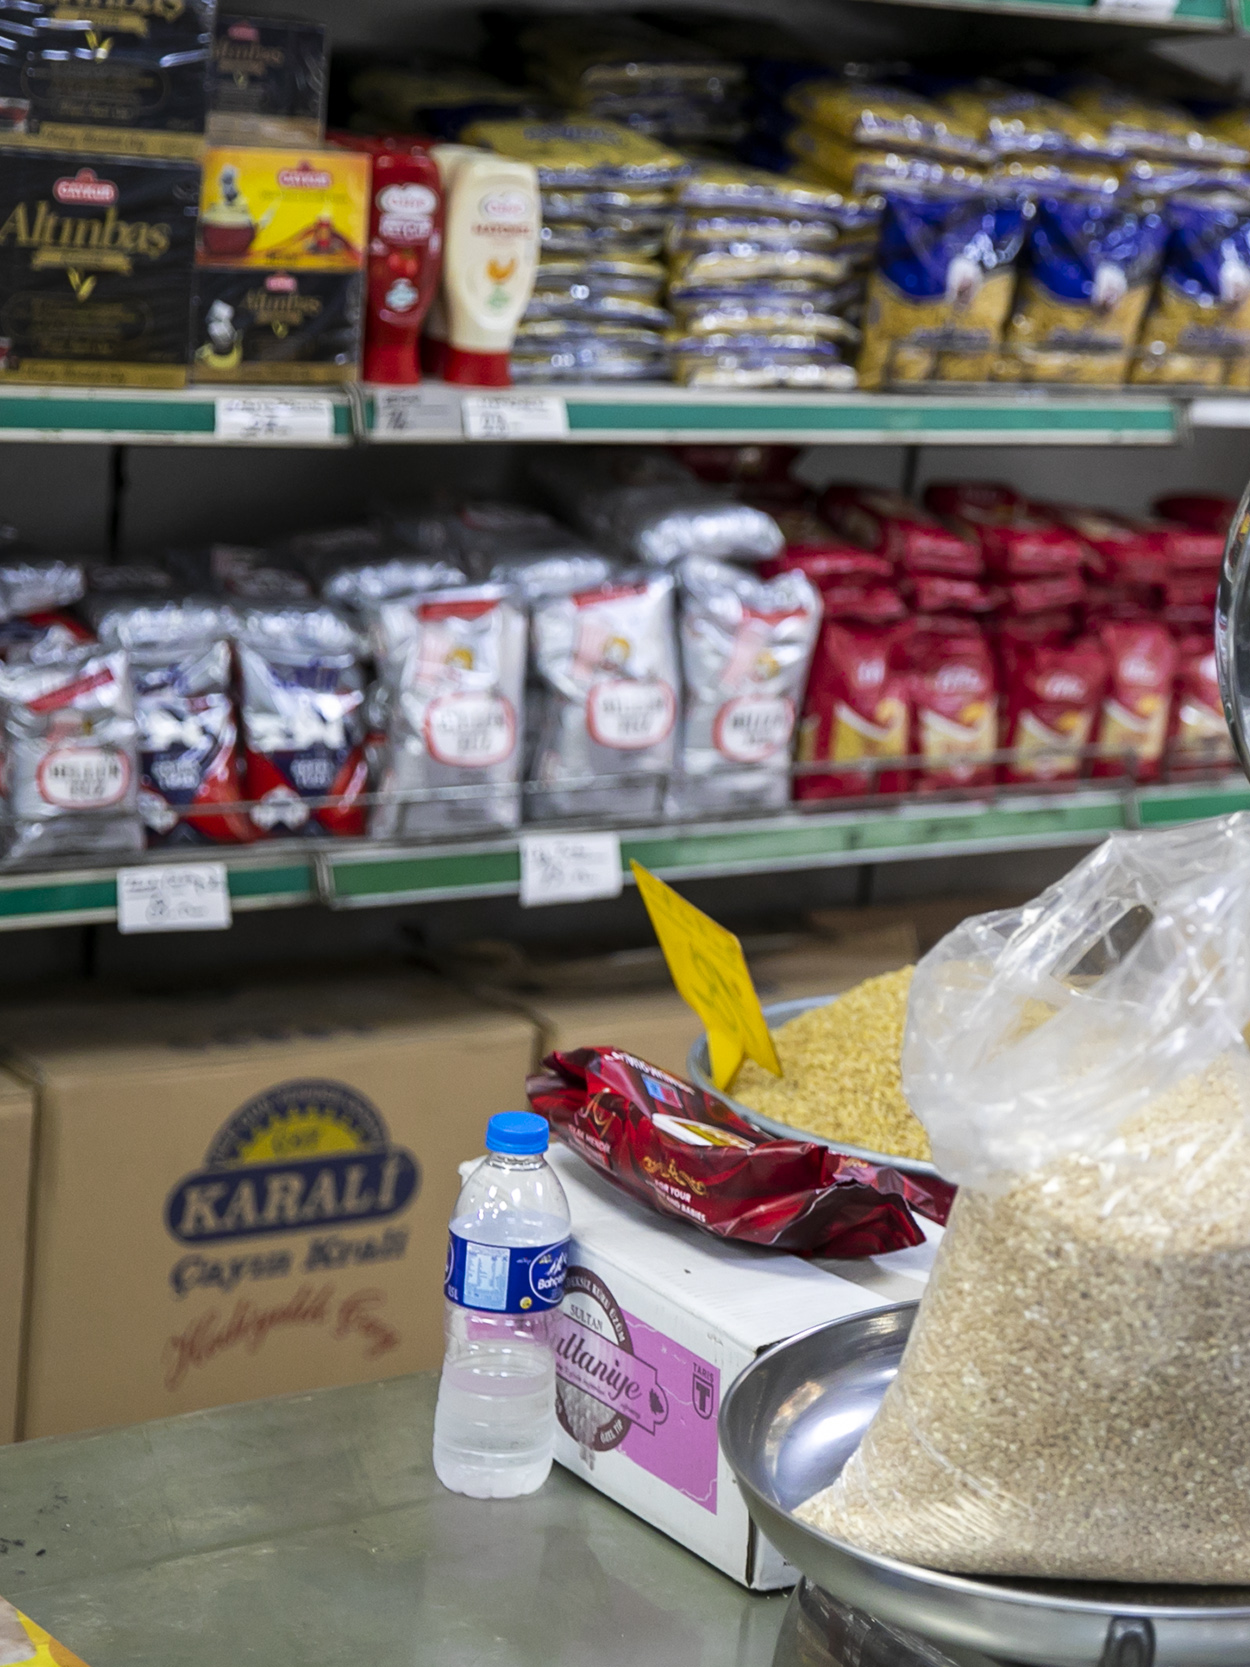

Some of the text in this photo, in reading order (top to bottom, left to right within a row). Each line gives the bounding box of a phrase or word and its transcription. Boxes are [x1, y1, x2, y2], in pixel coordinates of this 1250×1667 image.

[670, 1186, 692, 1203] YOUR
[681, 1203, 706, 1223] BABIES
[570, 1304, 603, 1332] SULTAN
[609, 1307, 626, 1343] ÜZÜM
[613, 1418, 624, 1435] TİP
